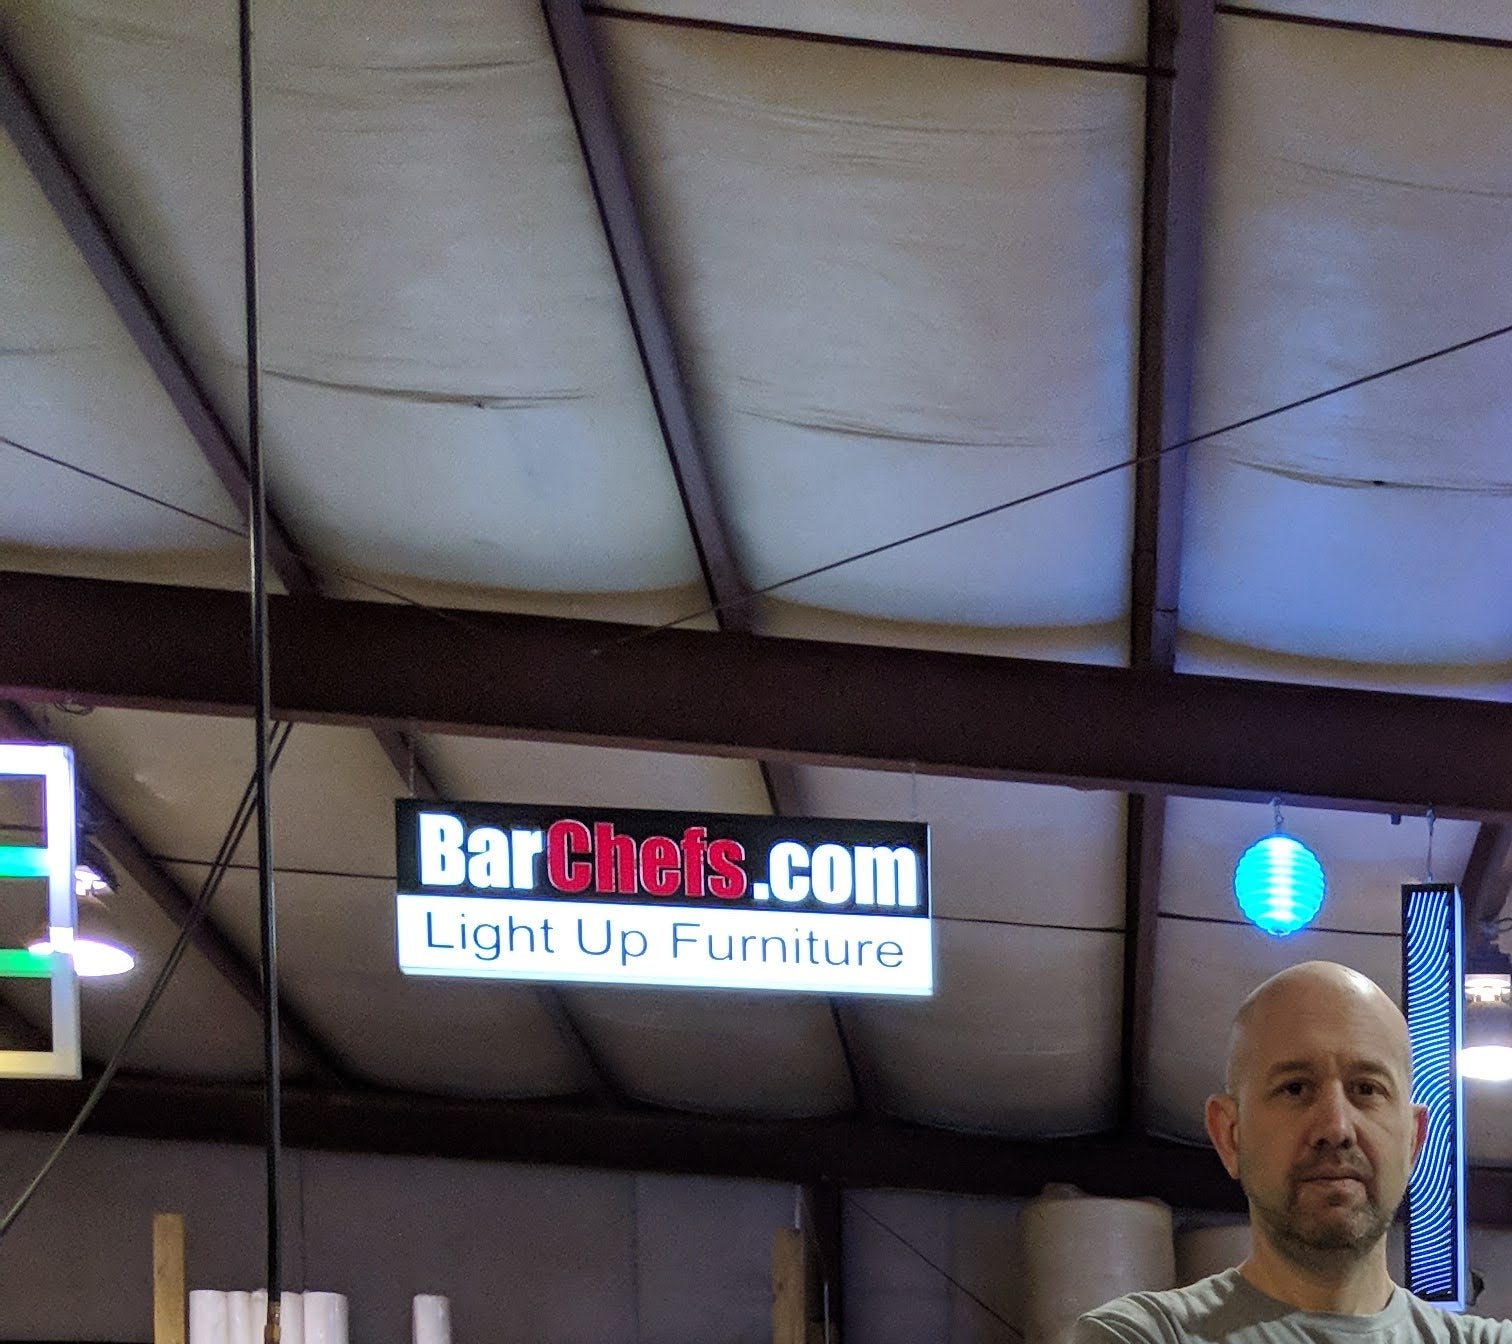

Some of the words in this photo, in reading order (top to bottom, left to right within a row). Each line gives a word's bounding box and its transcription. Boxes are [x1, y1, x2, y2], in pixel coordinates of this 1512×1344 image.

[418, 812, 919, 907] BarChefs.com
[426, 911, 555, 961] Light
[576, 917, 648, 967] Up
[672, 922, 905, 968] Furniture
